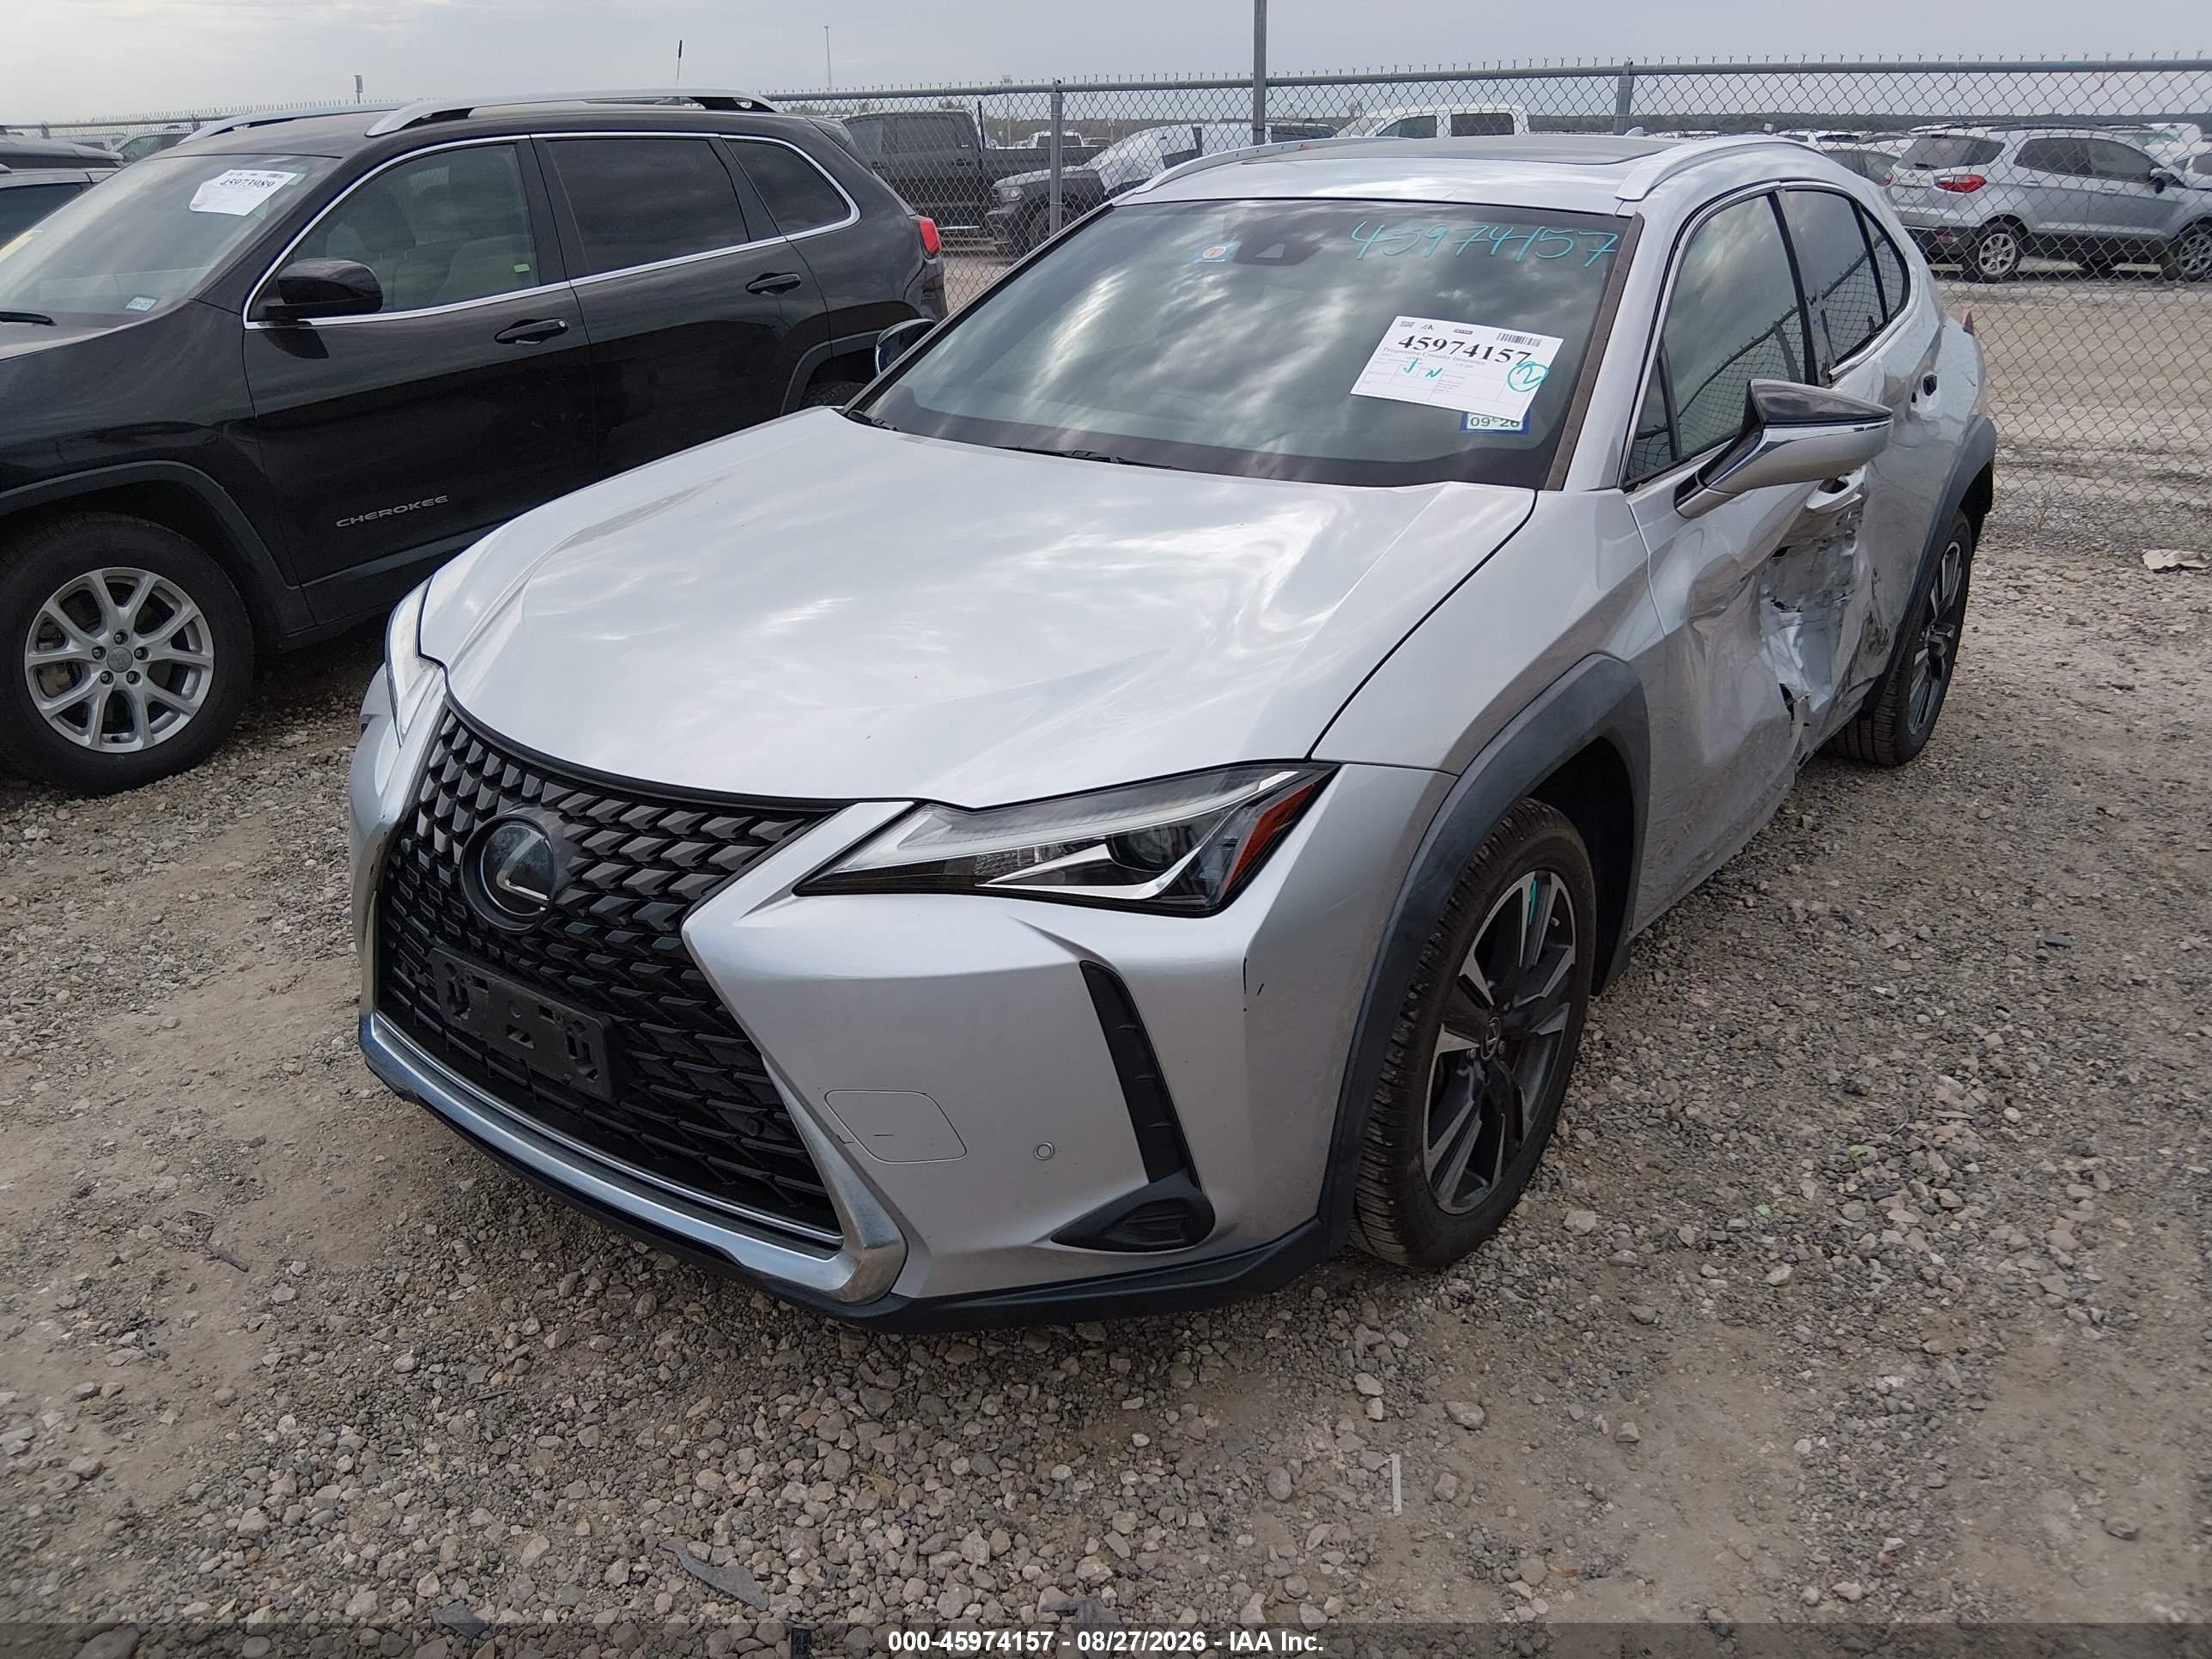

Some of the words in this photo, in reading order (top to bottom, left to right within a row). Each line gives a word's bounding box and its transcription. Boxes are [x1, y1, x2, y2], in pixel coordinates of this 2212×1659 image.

[1351, 221, 1619, 267] 45974157
[1398, 335, 1532, 366] 45974157
[336, 495, 448, 527] CHEROKEE
